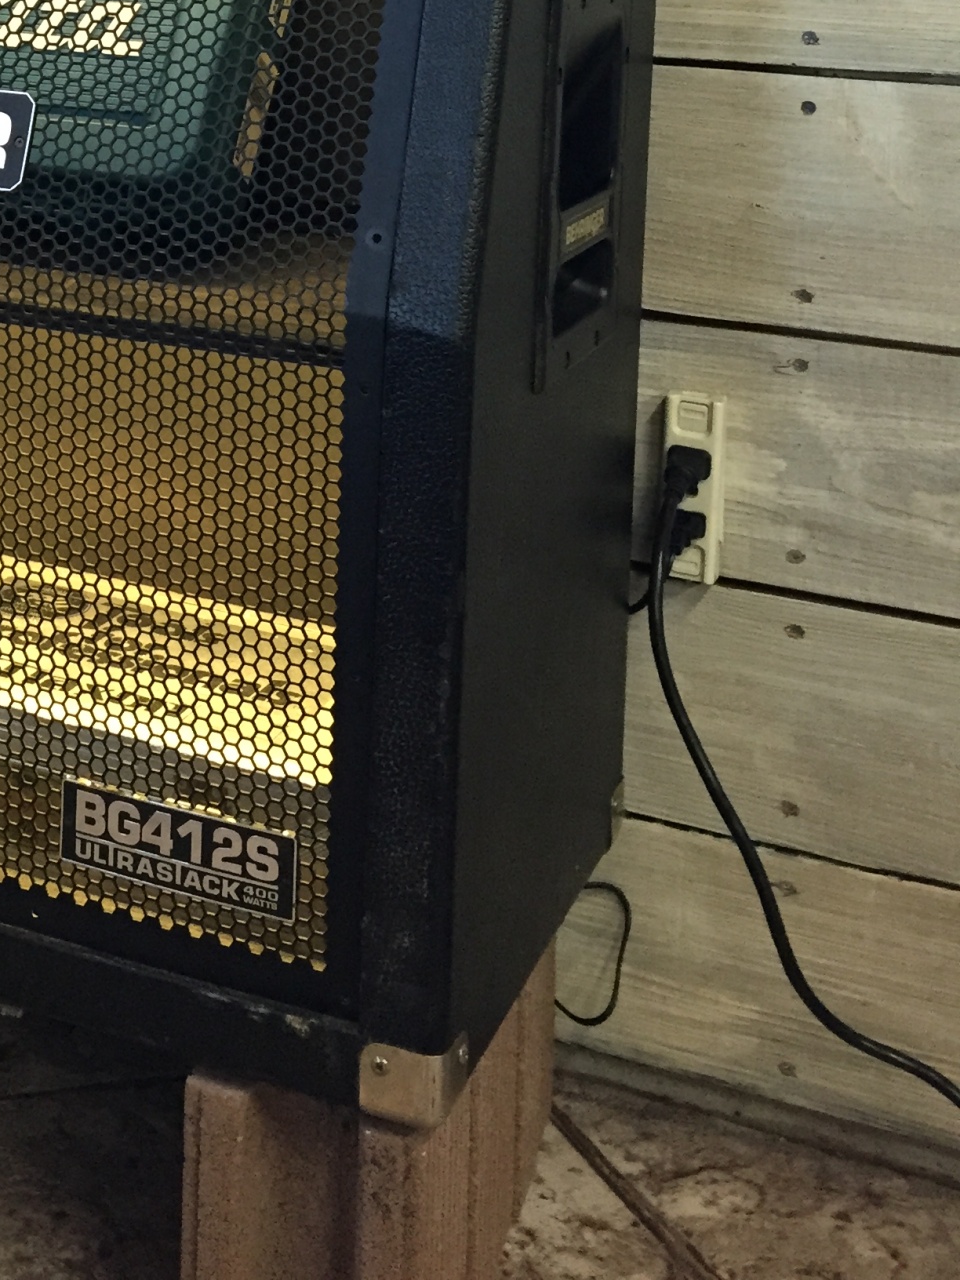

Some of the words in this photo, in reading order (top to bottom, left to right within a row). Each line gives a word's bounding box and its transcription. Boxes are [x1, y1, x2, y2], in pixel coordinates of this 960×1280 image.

[74, 788, 280, 882] BG412S
[74, 837, 241, 902] ULTRASTACK
[243, 885, 280, 902] 400
[242, 894, 278, 911] WATTS
